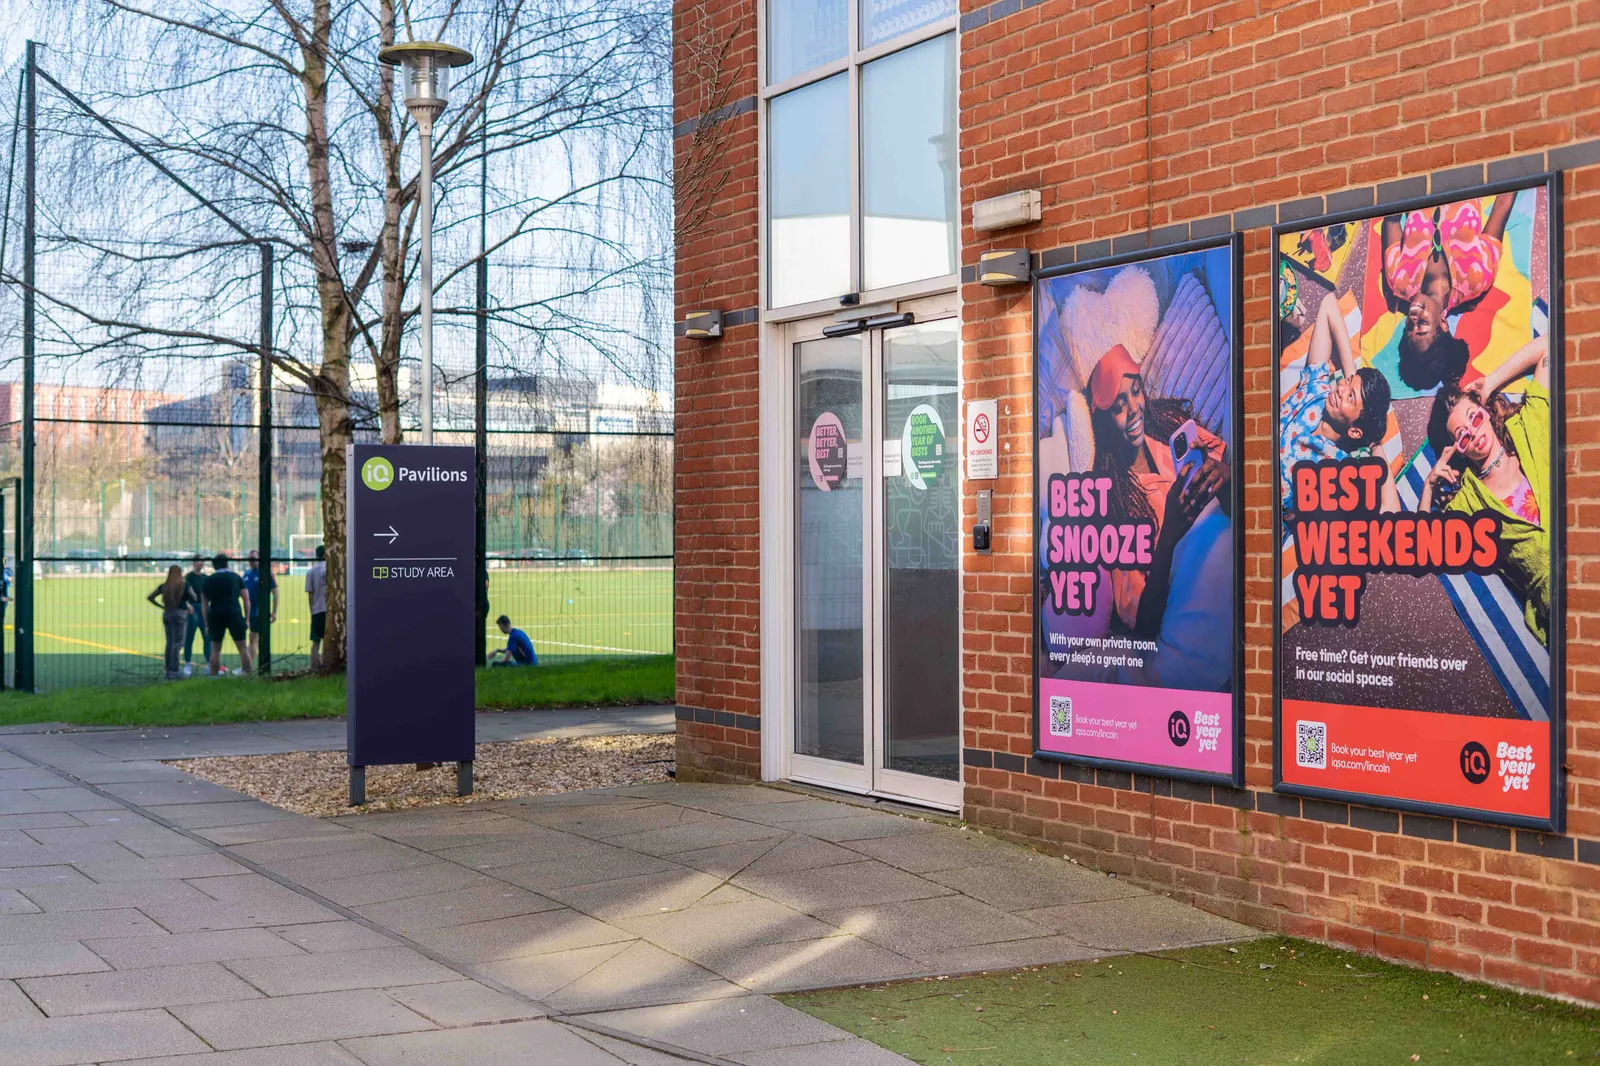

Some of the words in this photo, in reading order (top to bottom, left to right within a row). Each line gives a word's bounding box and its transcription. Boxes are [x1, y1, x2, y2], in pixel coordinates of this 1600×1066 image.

[912, 414, 927, 424] BOOK
[816, 426, 838, 437] BETTER,
[912, 425, 937, 435] ANOTHER
[816, 437, 838, 448] BETTER,
[912, 436, 926, 446] YEAR
[927, 435, 934, 445] OF
[816, 449, 830, 459] BEST
[912, 446, 928, 456] BESTS
[367, 464, 390, 483] iQ
[399, 467, 468, 482] Pavilions
[1296, 465, 1383, 512] BEST
[1051, 478, 1113, 518] BEST
[1050, 524, 1152, 564] SNOOZE
[1297, 518, 1497, 567] WEEKENDS
[391, 567, 425, 578] STUDY
[427, 567, 454, 578] AREA
[1050, 571, 1097, 610] YET
[1297, 574, 1361, 620] YET
[1050, 633, 1066, 645] With
[1067, 636, 1084, 647] your
[1085, 638, 1102, 647] own
[1103, 636, 1132, 651] private
[1133, 640, 1158, 652] room,
[1050, 653, 1070, 664] every
[1097, 656, 1102, 665] a
[1104, 655, 1126, 667] great
[1127, 658, 1143, 667] one
[1296, 647, 1318, 661] Free
[1320, 648, 1348, 664] time?
[1349, 650, 1369, 665] Get
[1370, 654, 1396, 668] your
[1398, 652, 1438, 670] friends
[1441, 659, 1468, 671] over
[1296, 666, 1305, 680] in
[1307, 670, 1324, 681] our
[1326, 669, 1354, 684] social
[1356, 673, 1393, 687] spaces
[1075, 714, 1088, 724] Book
[1089, 717, 1101, 726] your
[1102, 717, 1114, 727] best
[1114, 720, 1127, 730] year
[1128, 721, 1137, 730] yet
[1194, 711, 1220, 726] Best
[1075, 728, 1118, 739] iqsa.com/lincoln
[1171, 719, 1188, 739] iQ
[1195, 724, 1221, 740] year
[1198, 737, 1218, 753] yet
[1332, 743, 1348, 755] Book
[1349, 748, 1367, 758] your
[1368, 748, 1384, 759] best
[1386, 752, 1403, 762] year
[1404, 752, 1417, 763] yet
[1496, 742, 1533, 760] Best
[1332, 759, 1390, 774] iqsa.com/lincoln
[1464, 751, 1486, 776] iQ
[1498, 758, 1536, 776] year
[1502, 775, 1530, 793] yet
